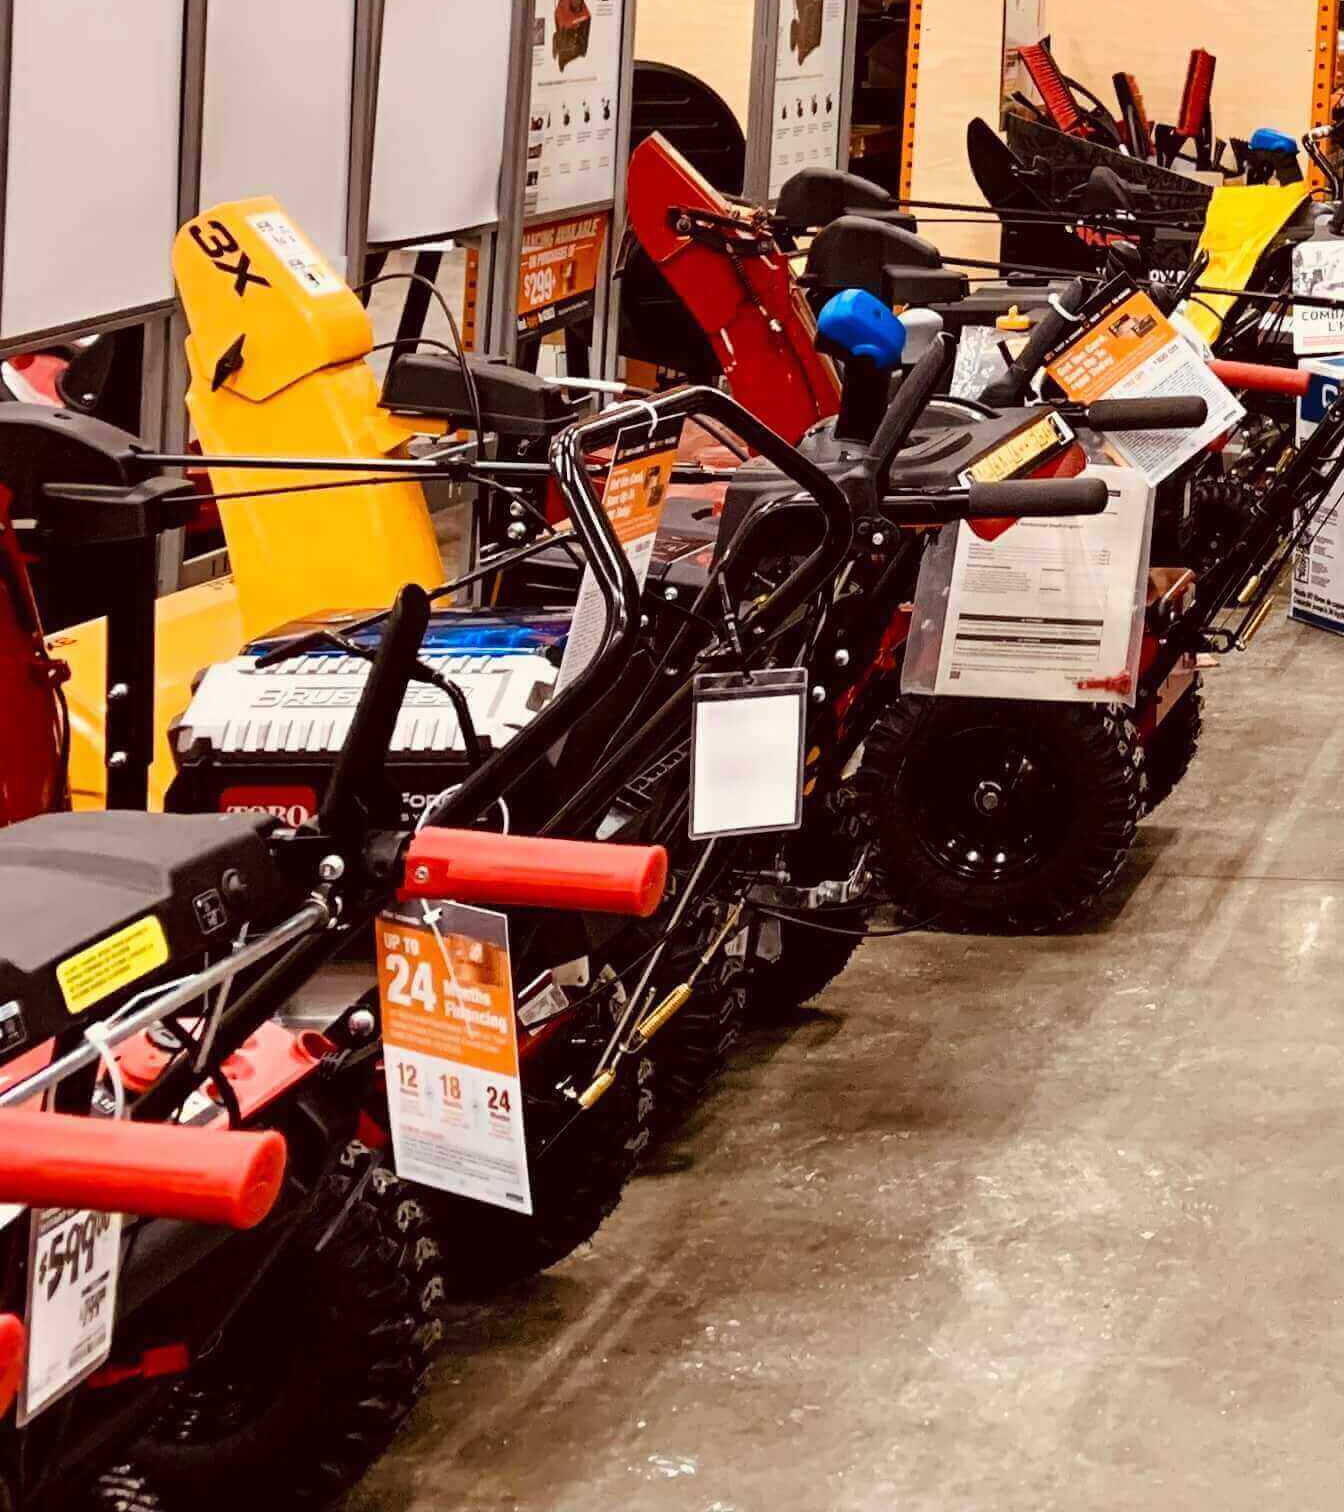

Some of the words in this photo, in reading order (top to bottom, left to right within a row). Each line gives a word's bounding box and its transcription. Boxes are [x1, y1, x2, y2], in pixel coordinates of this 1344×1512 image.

[189, 220, 272, 296] 3X
[383, 932, 402, 950] UP
[403, 934, 420, 956] TO
[385, 953, 437, 1013] 24
[444, 999, 508, 1035] Financing
[397, 1061, 419, 1089] 12
[439, 1073, 461, 1100] 18
[487, 1085, 512, 1113] 24
